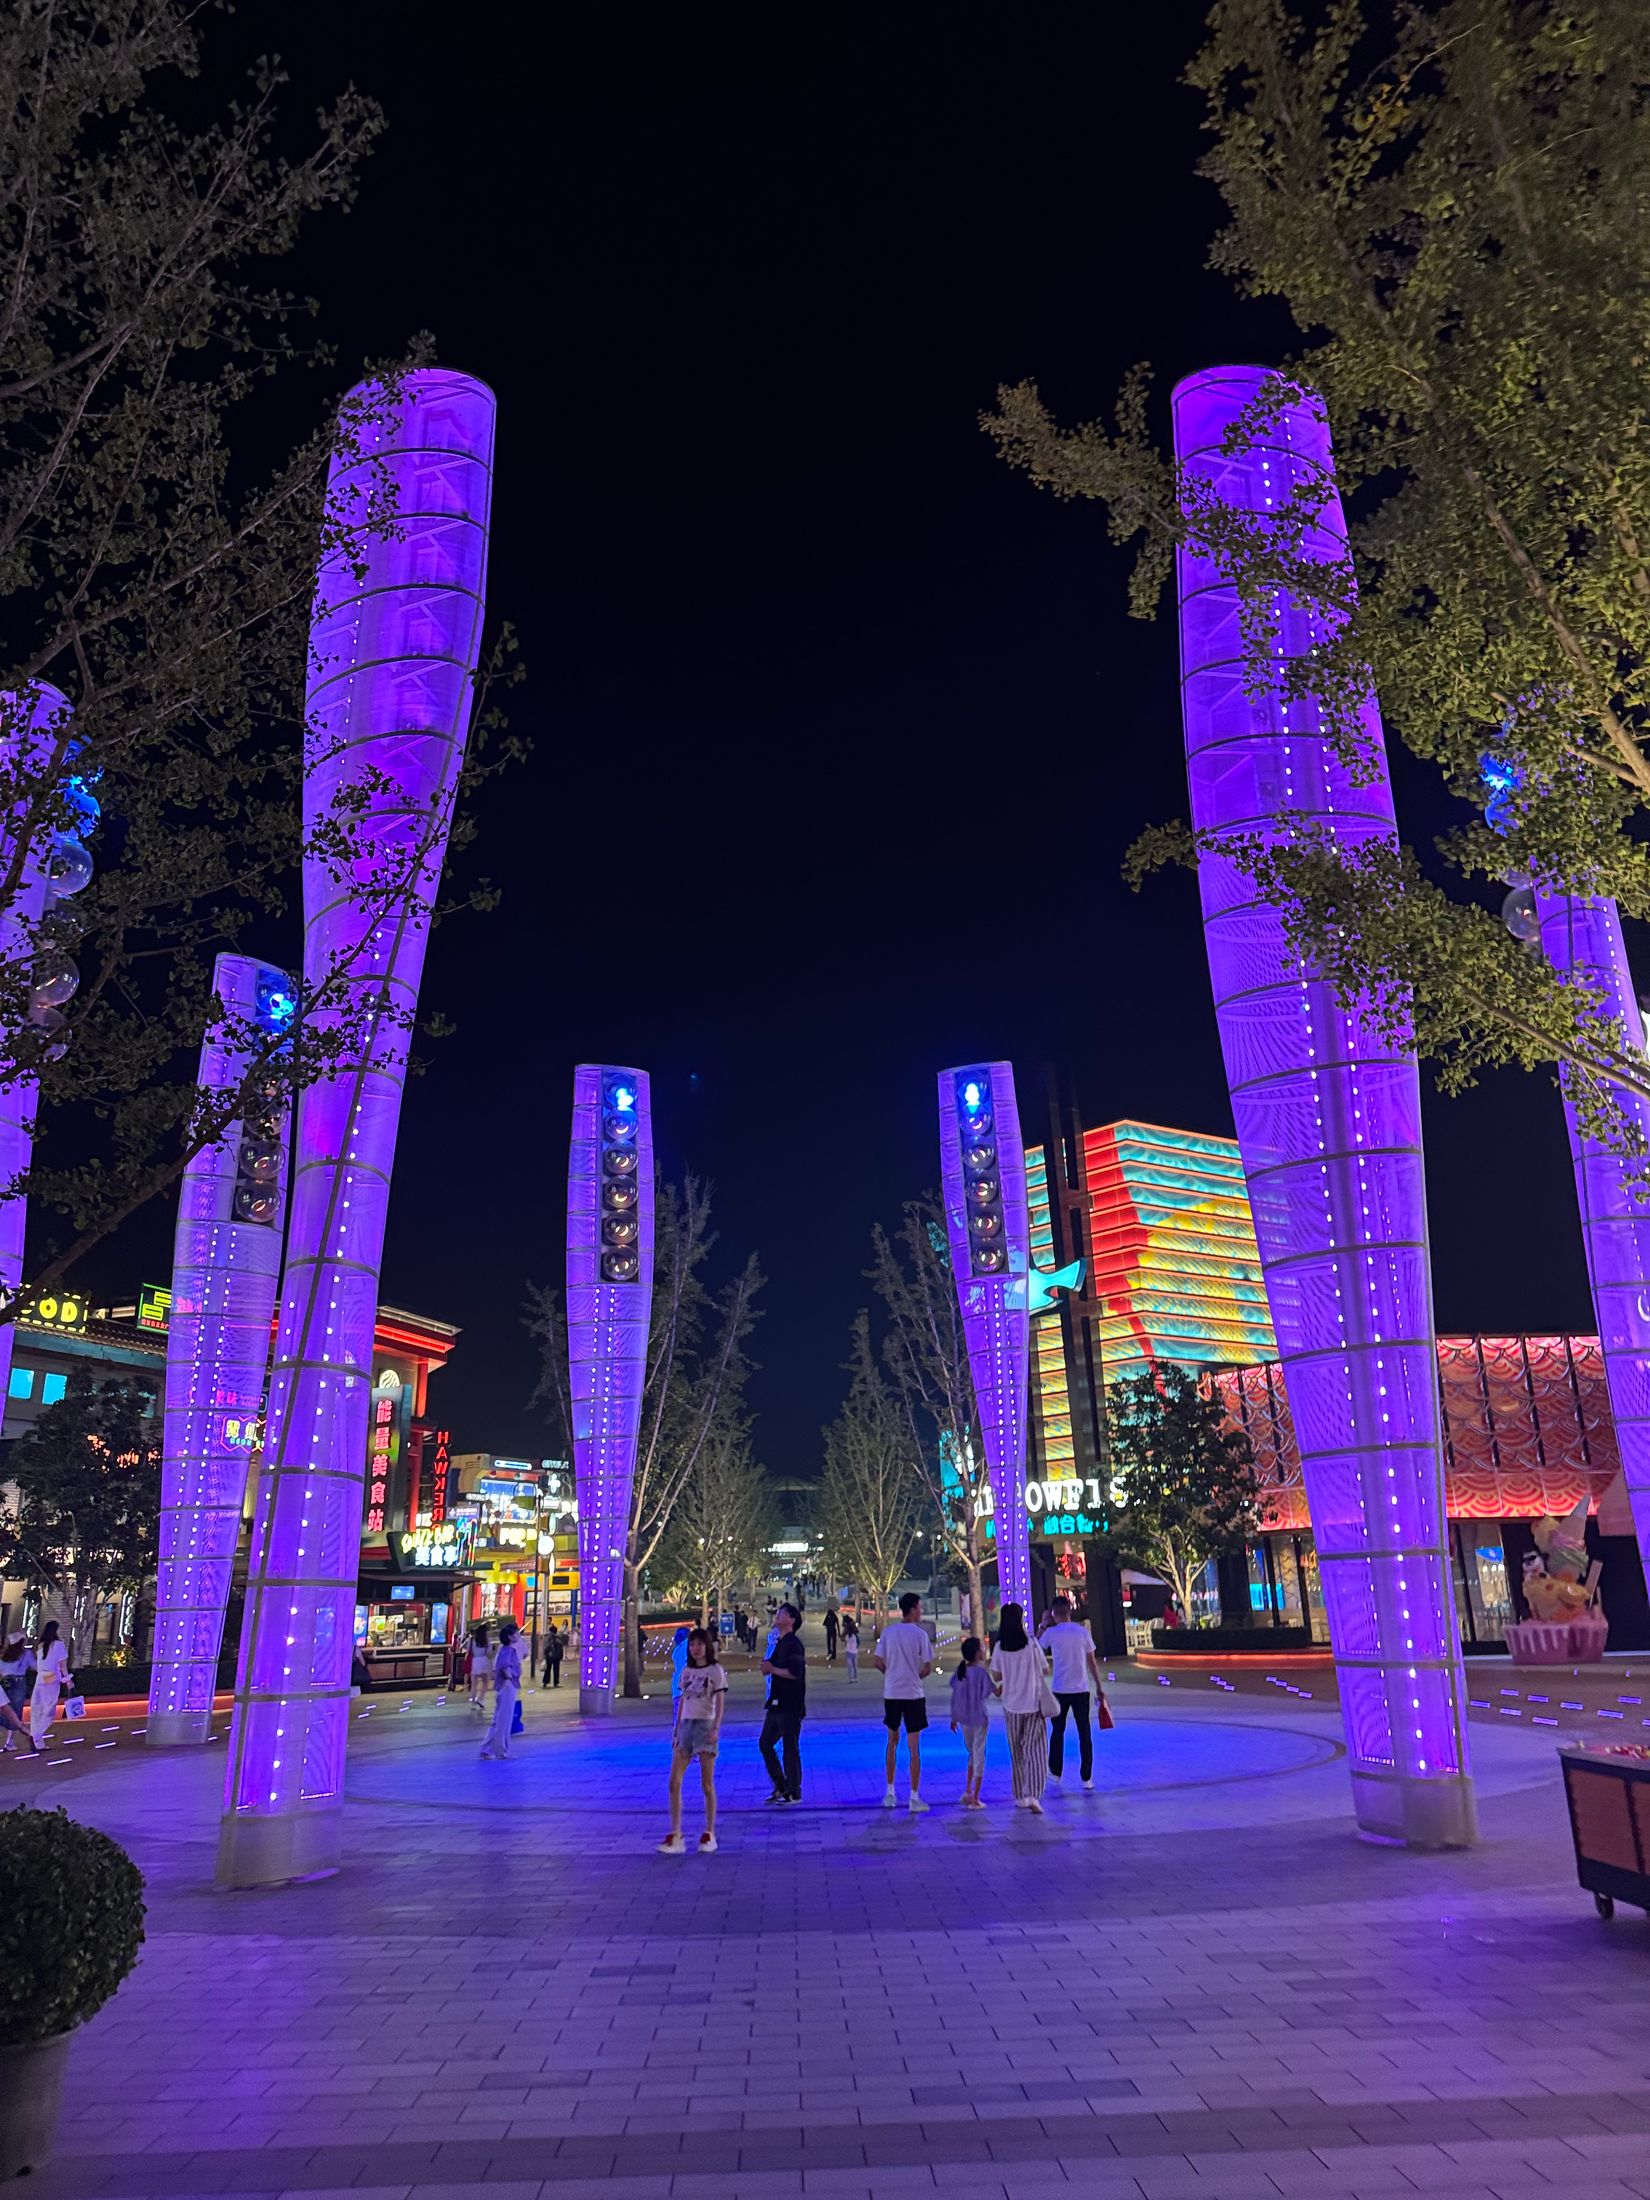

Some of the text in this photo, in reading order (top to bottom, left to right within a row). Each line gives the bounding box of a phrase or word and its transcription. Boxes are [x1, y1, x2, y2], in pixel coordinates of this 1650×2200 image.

[367, 1399, 393, 1532] 能量美食站
